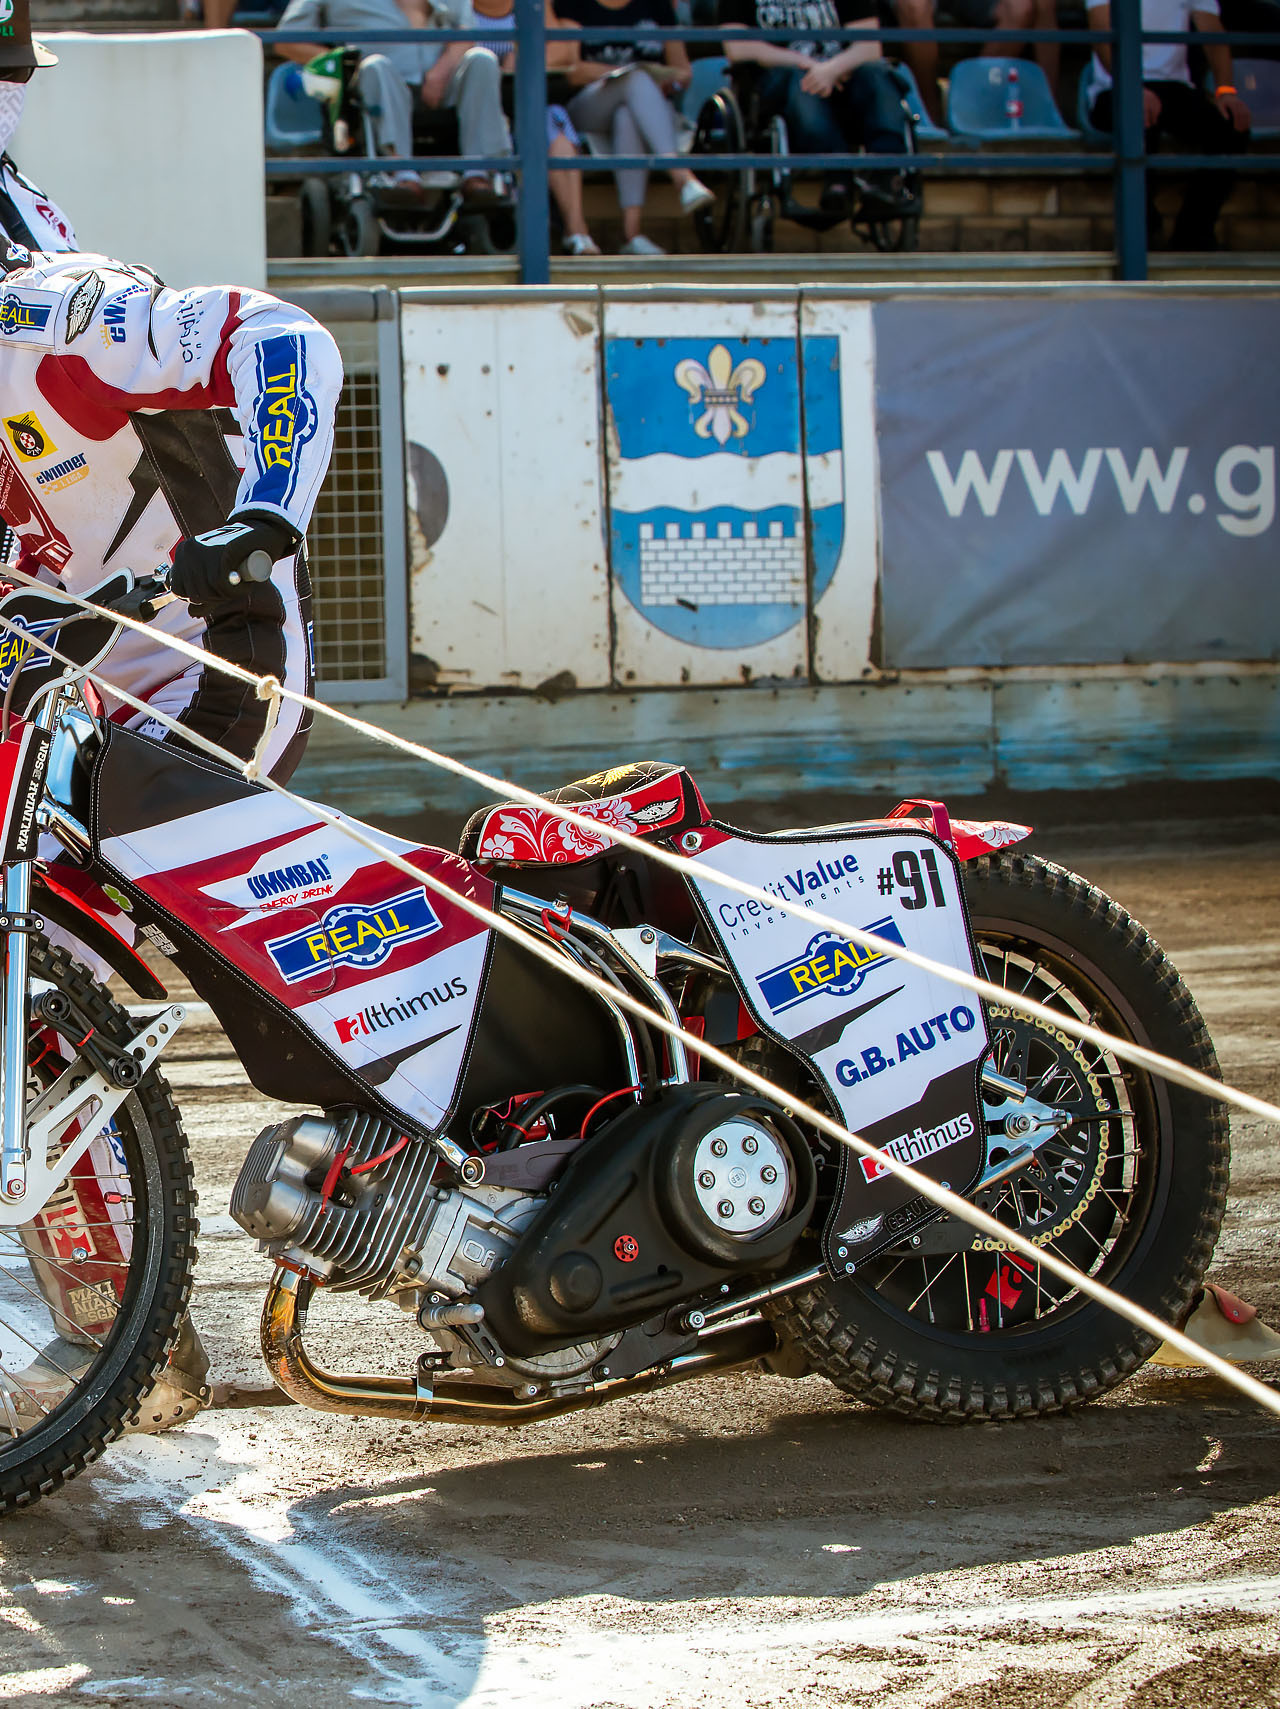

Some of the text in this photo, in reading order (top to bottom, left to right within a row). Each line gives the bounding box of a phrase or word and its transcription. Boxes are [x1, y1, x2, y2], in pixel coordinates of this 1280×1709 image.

[263, 363, 296, 469] REALL
[926, 444, 1276, 538] www.g
[260, 884, 334, 914] ENERGY DRINK
[729, 875, 866, 941] Invesments
[305, 909, 410, 962] REALL
[336, 976, 468, 1043] althimus
[835, 1005, 976, 1088] G.B. AUTO
